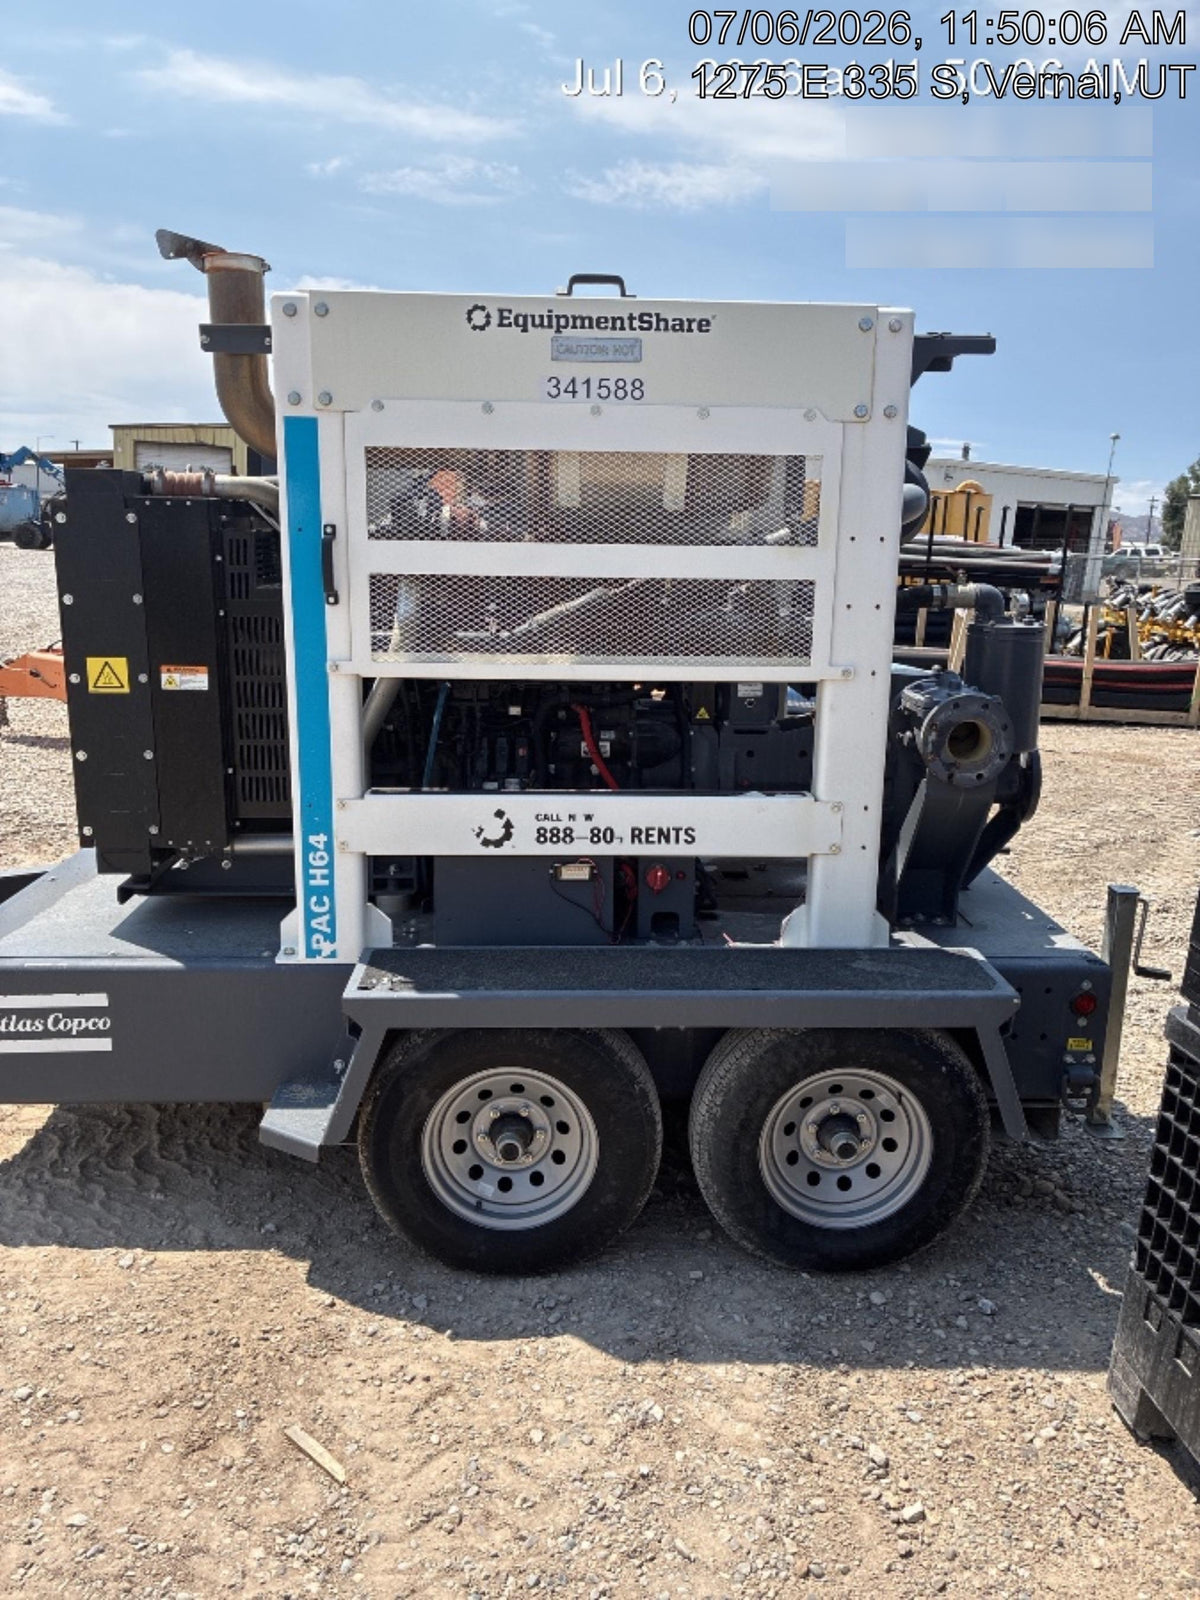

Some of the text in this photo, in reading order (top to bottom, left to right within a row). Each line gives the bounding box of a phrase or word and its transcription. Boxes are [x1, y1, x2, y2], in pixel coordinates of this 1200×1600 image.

[497, 308, 712, 334] EquipmentShare
[546, 376, 645, 401] 341588
[535, 813, 563, 822] CALL
[630, 826, 696, 845] RENTS
[308, 833, 330, 887] H64
[0, 1012, 111, 1035] tlas Copco
